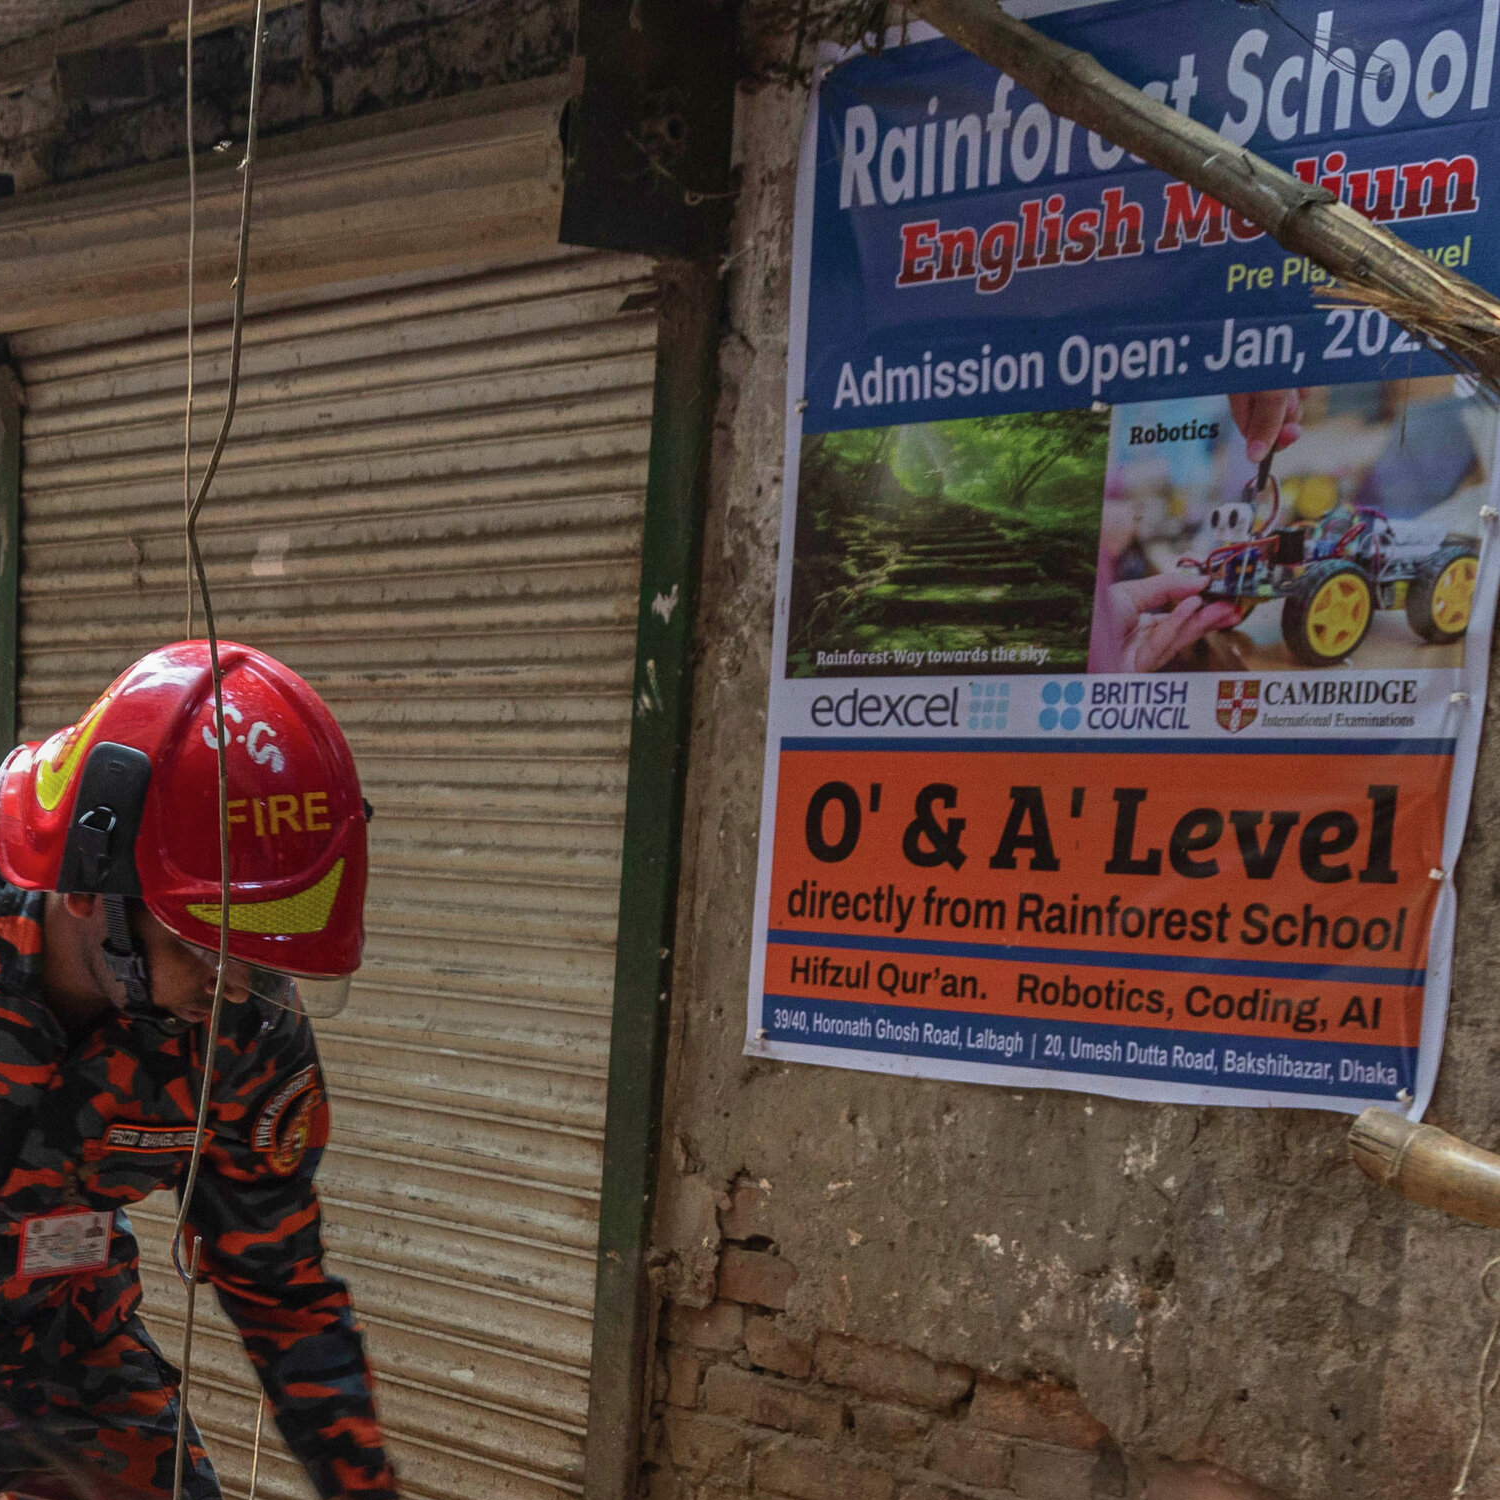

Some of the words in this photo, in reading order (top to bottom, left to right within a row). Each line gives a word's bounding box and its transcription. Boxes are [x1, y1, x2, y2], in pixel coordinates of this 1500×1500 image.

[1218, 0, 1500, 150] School
[897, 185, 1146, 296] English
[1227, 263, 1275, 292] Pre
[833, 342, 1045, 411] Admission
[1058, 331, 1189, 397] Open:
[1204, 318, 1305, 374] Jan,
[1129, 419, 1220, 446] Robotics
[816, 649, 923, 667] Rainforest-Way
[928, 646, 989, 665] towards
[991, 646, 1016, 663] the
[811, 687, 959, 727] edexcel
[1091, 681, 1189, 705] BRITISH
[1264, 680, 1418, 706] CAMBRIDGE
[1087, 707, 1190, 731] COUNCIL
[1261, 712, 1331, 728] International
[1334, 712, 1415, 728] Examinations
[226, 791, 332, 840] FIRE
[901, 782, 968, 872] &
[1104, 783, 1400, 887] Level
[787, 880, 916, 934] directly
[922, 884, 1006, 933] from
[1016, 890, 1229, 945] Rainforest
[1239, 902, 1407, 953] School
[790, 956, 870, 990] Hifzul
[1016, 972, 1175, 1022] Robotics,
[1184, 985, 1329, 1034] Coding,
[1338, 996, 1384, 1031] AI
[772, 1008, 810, 1036] 39/40,
[813, 1016, 873, 1038] Horonath
[875, 1018, 921, 1044] Ghosh
[922, 1022, 963, 1051] Road,
[966, 1026, 1025, 1058] Lalbagh
[1043, 1034, 1066, 1061] 20,
[1069, 1036, 1123, 1063] Umesh
[1125, 1041, 1168, 1068] Dutta
[1171, 1045, 1220, 1075] Road,
[1223, 1050, 1335, 1085] Bakshibazar,
[1339, 1058, 1398, 1087] Dhaka
